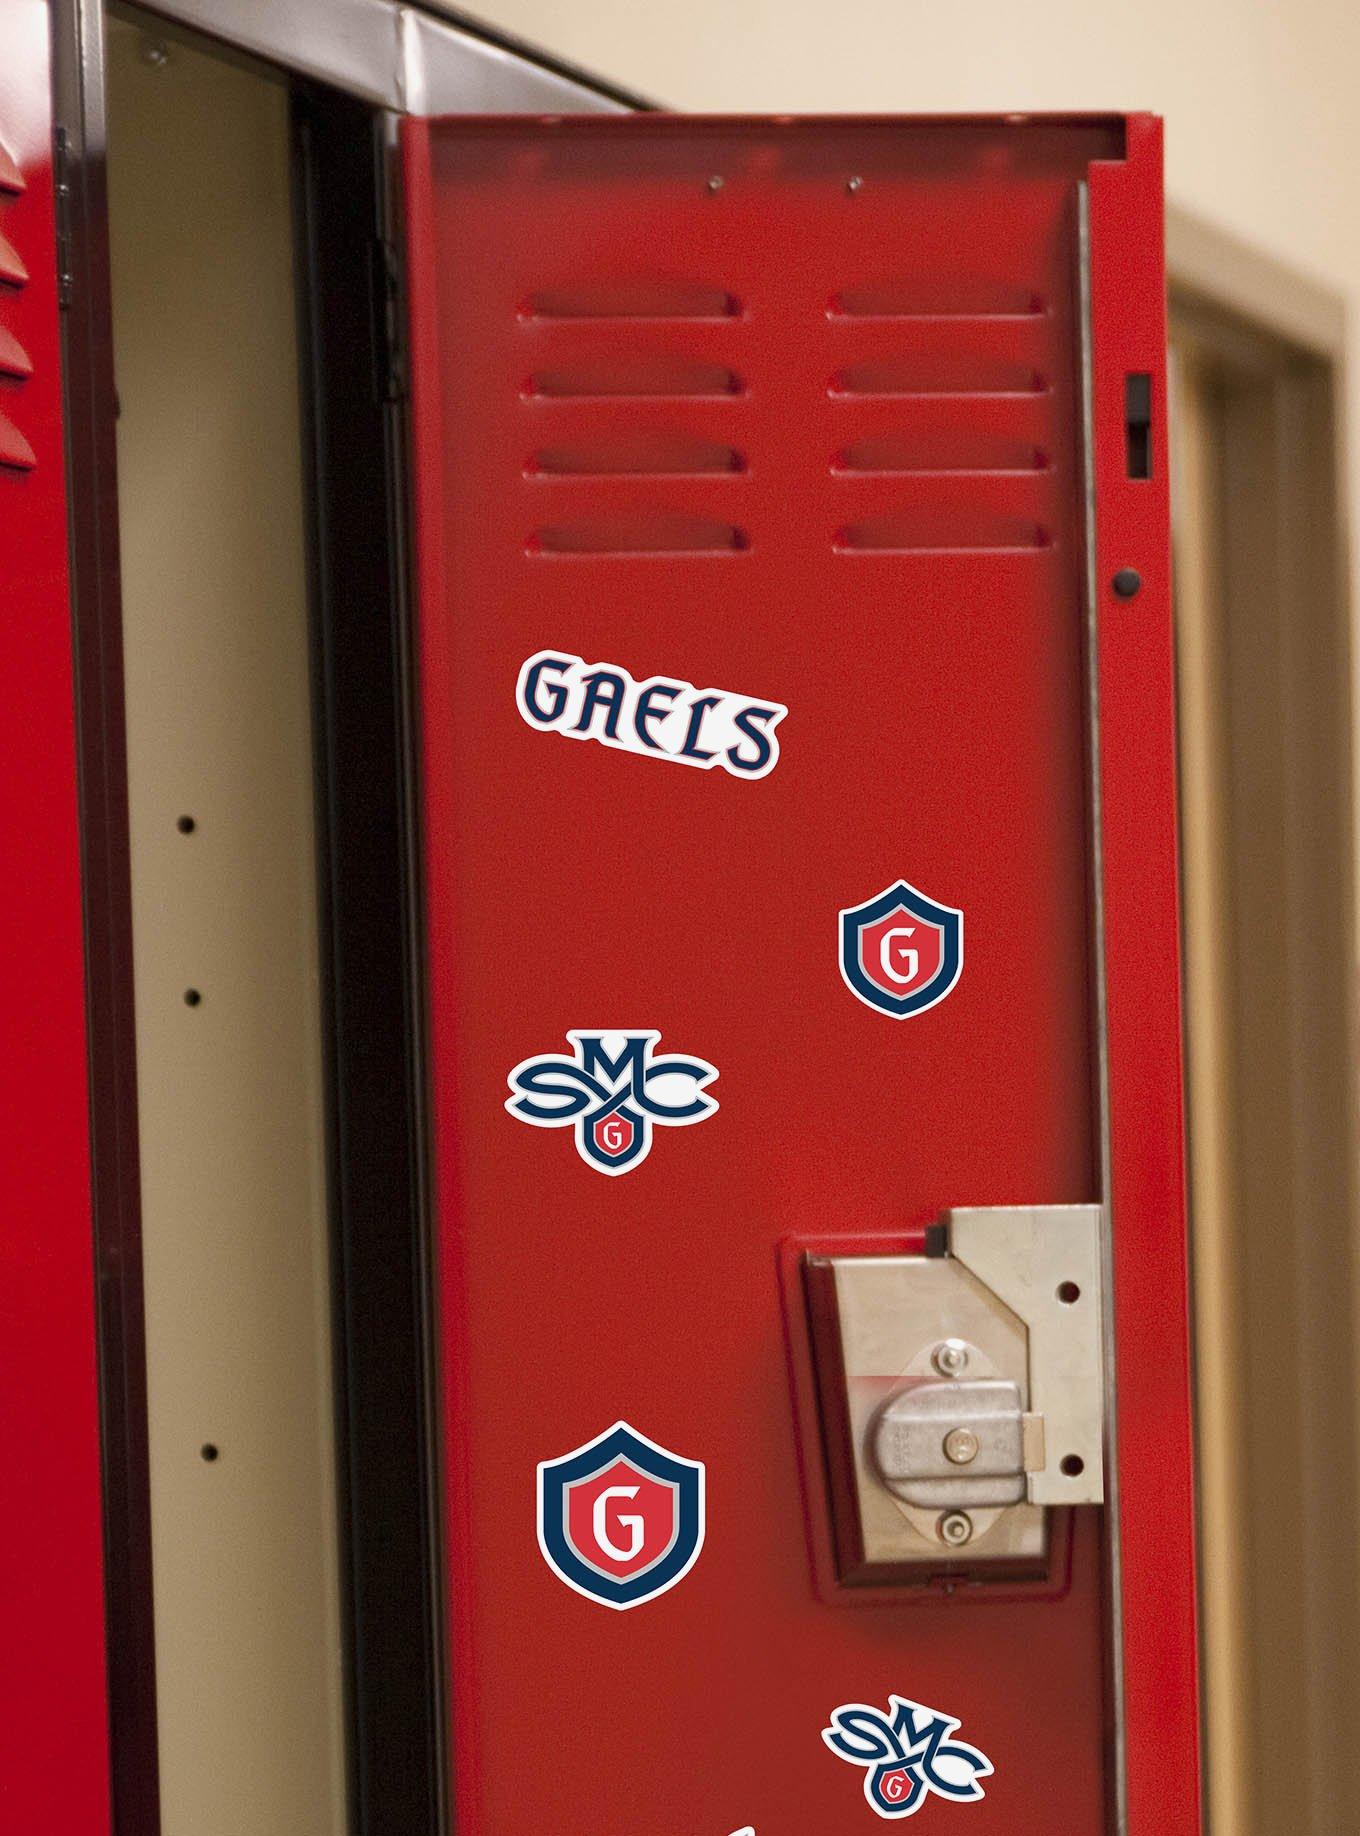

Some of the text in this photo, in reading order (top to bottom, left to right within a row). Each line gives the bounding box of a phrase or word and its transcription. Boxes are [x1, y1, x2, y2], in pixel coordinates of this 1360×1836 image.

[524, 658, 778, 772] GAELS
[880, 927, 919, 984] G
[514, 1037, 711, 1119] SMC
[602, 1121, 623, 1150] G
[592, 1485, 645, 1562] G
[829, 1703, 987, 1796] SMC
[885, 1775, 905, 1799] G
